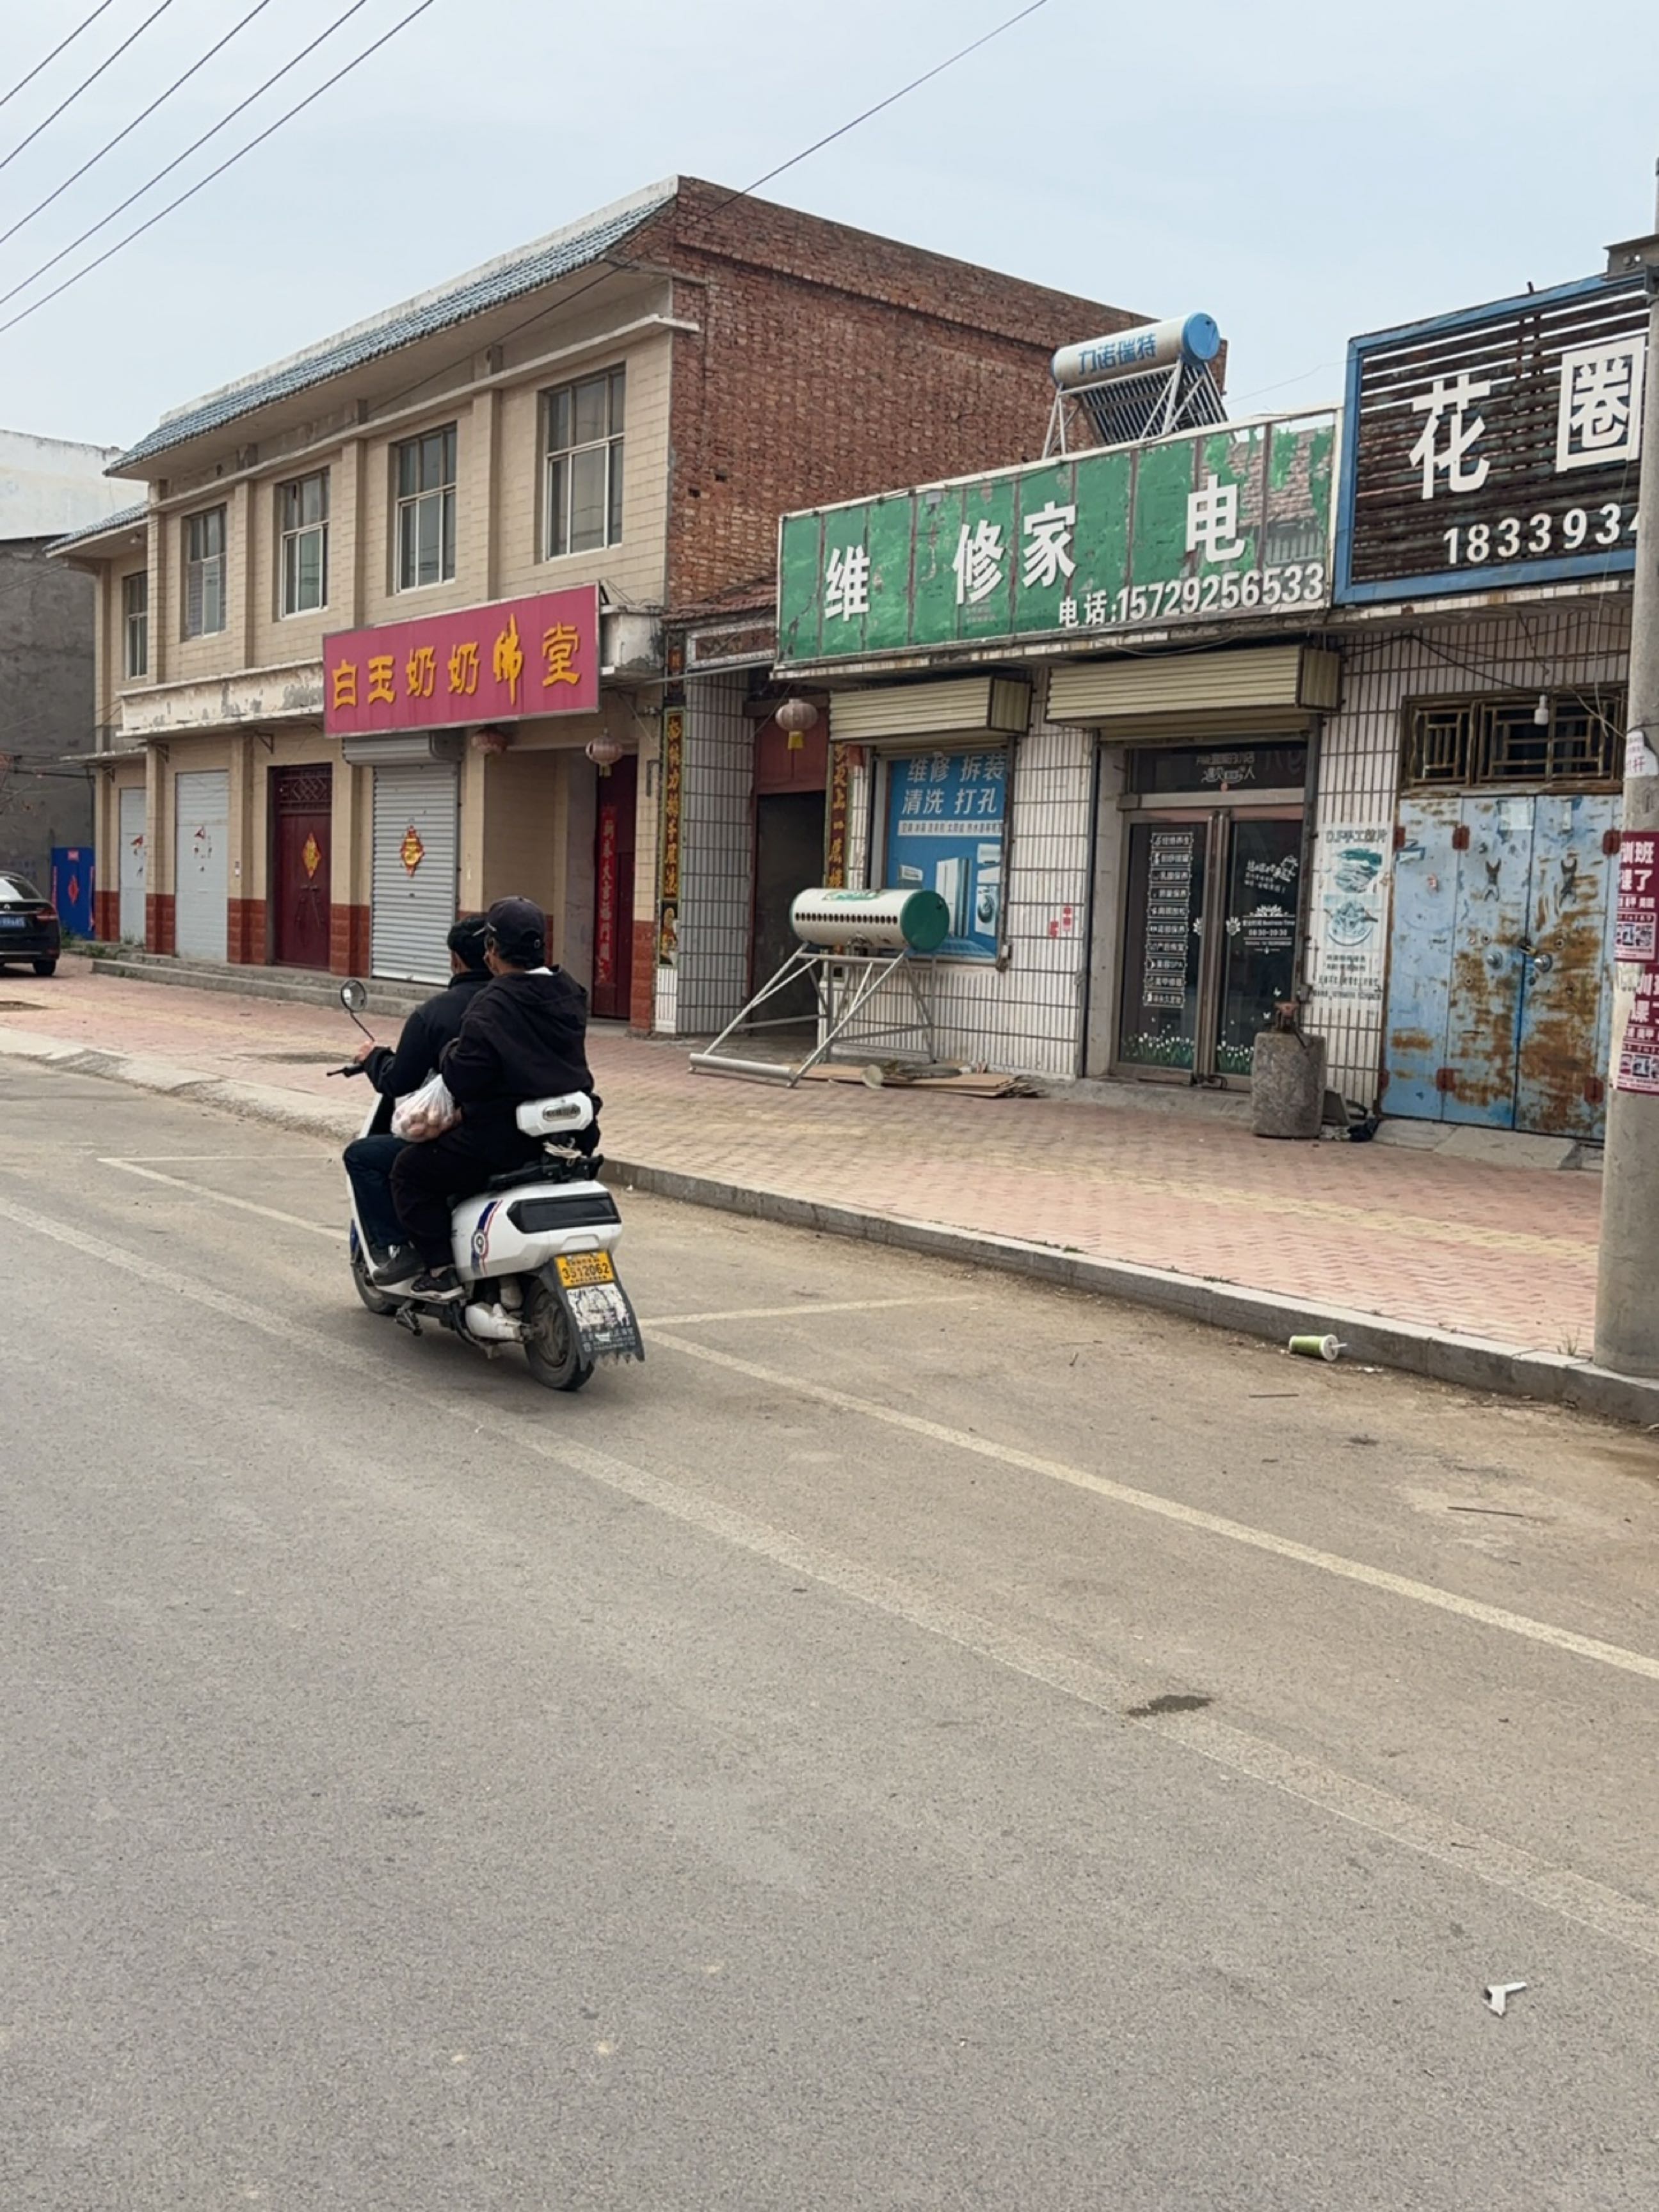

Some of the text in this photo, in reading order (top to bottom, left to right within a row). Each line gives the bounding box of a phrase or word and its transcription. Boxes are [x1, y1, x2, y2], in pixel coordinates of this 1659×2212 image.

[1078, 333, 1157, 375] 力诺瑞特
[1409, 336, 1645, 500] 花圈
[332, 613, 581, 710] 白玉奶奶佛堂
[906, 753, 1007, 783] 维修 拆装
[901, 787, 998, 815] 清洗 打孔
